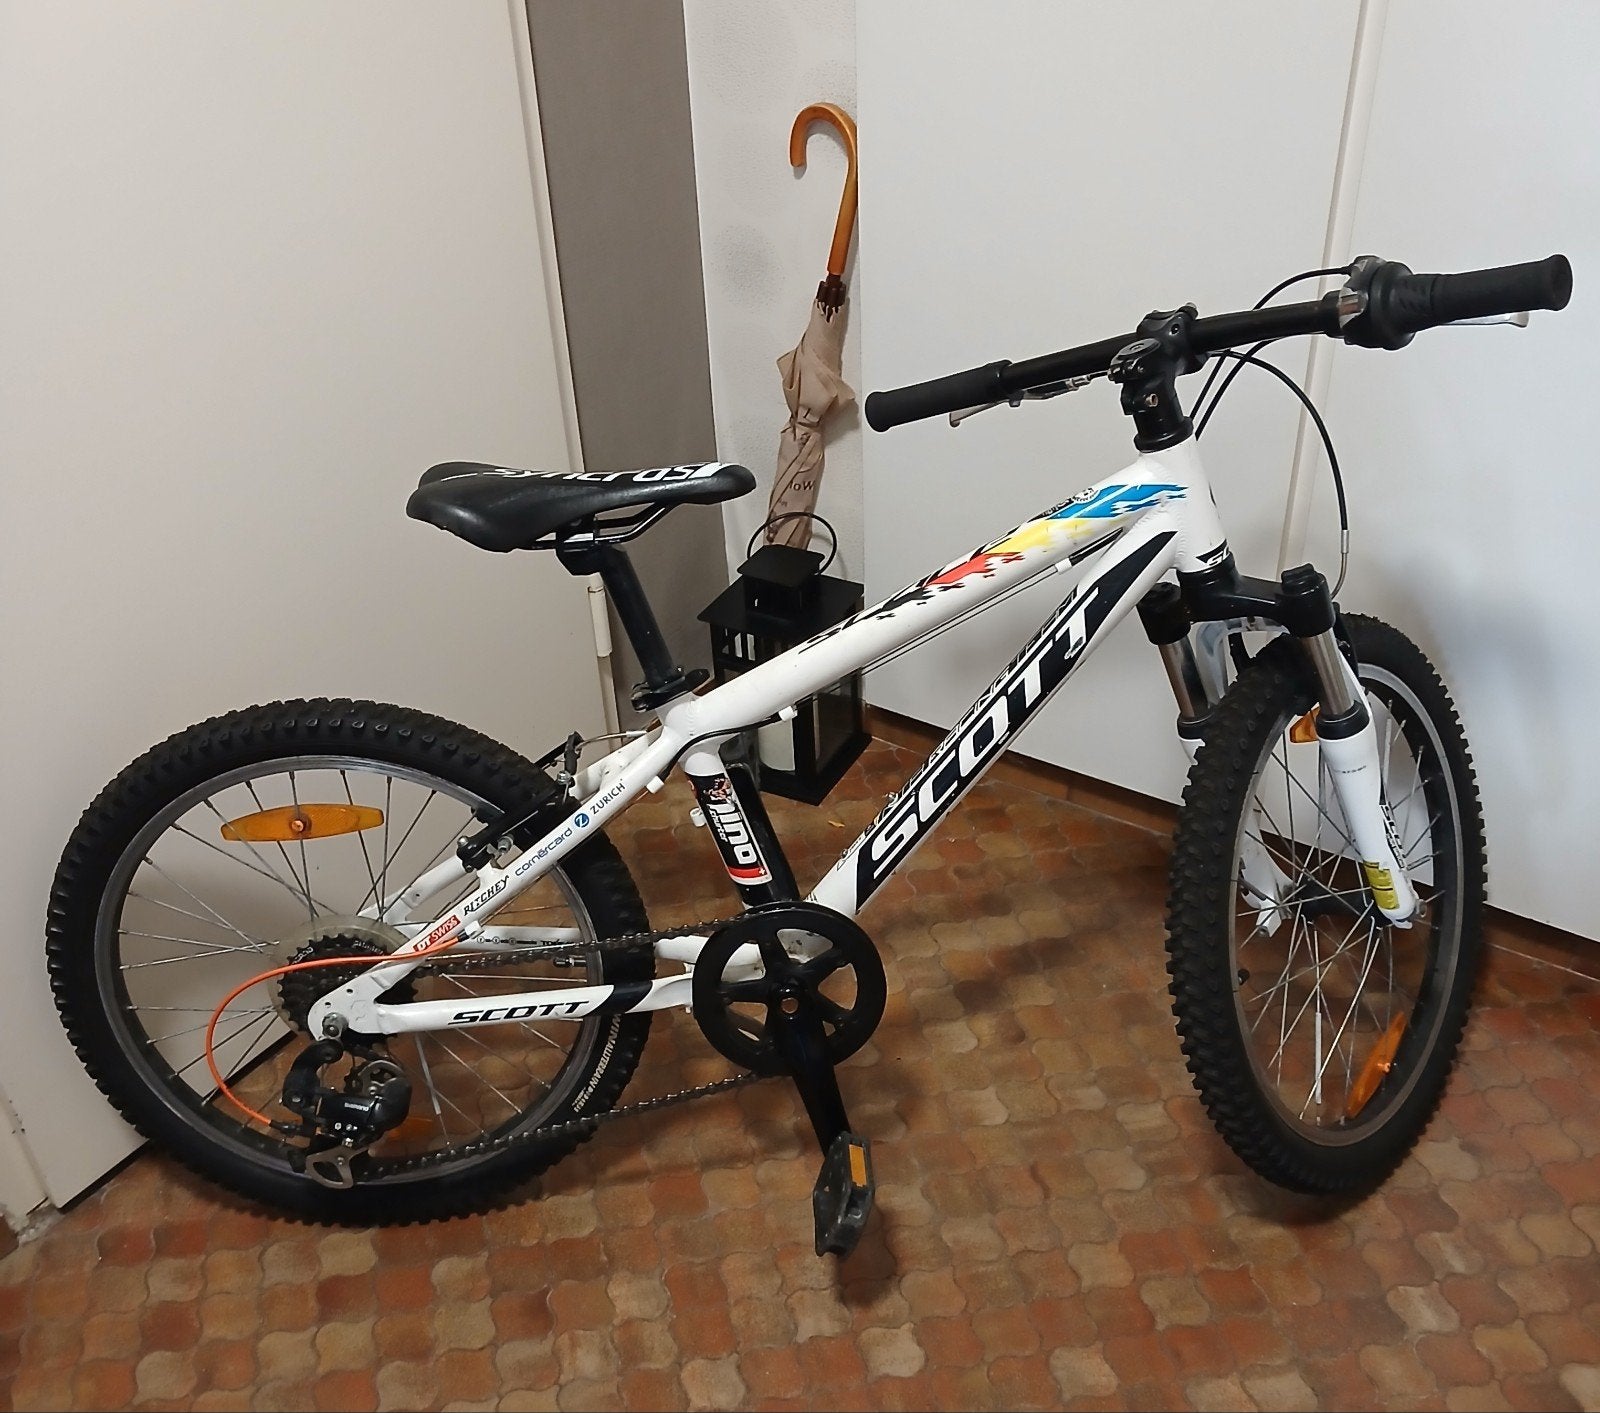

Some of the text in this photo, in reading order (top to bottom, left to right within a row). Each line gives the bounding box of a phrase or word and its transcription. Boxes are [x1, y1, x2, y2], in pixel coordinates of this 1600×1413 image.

[872, 587, 1099, 879] SCOTT
[590, 782, 626, 815] ZURICH
[463, 875, 510, 916] RITCHEY
[430, 916, 459, 941] SWISS
[448, 1001, 589, 1025] SCOTT
